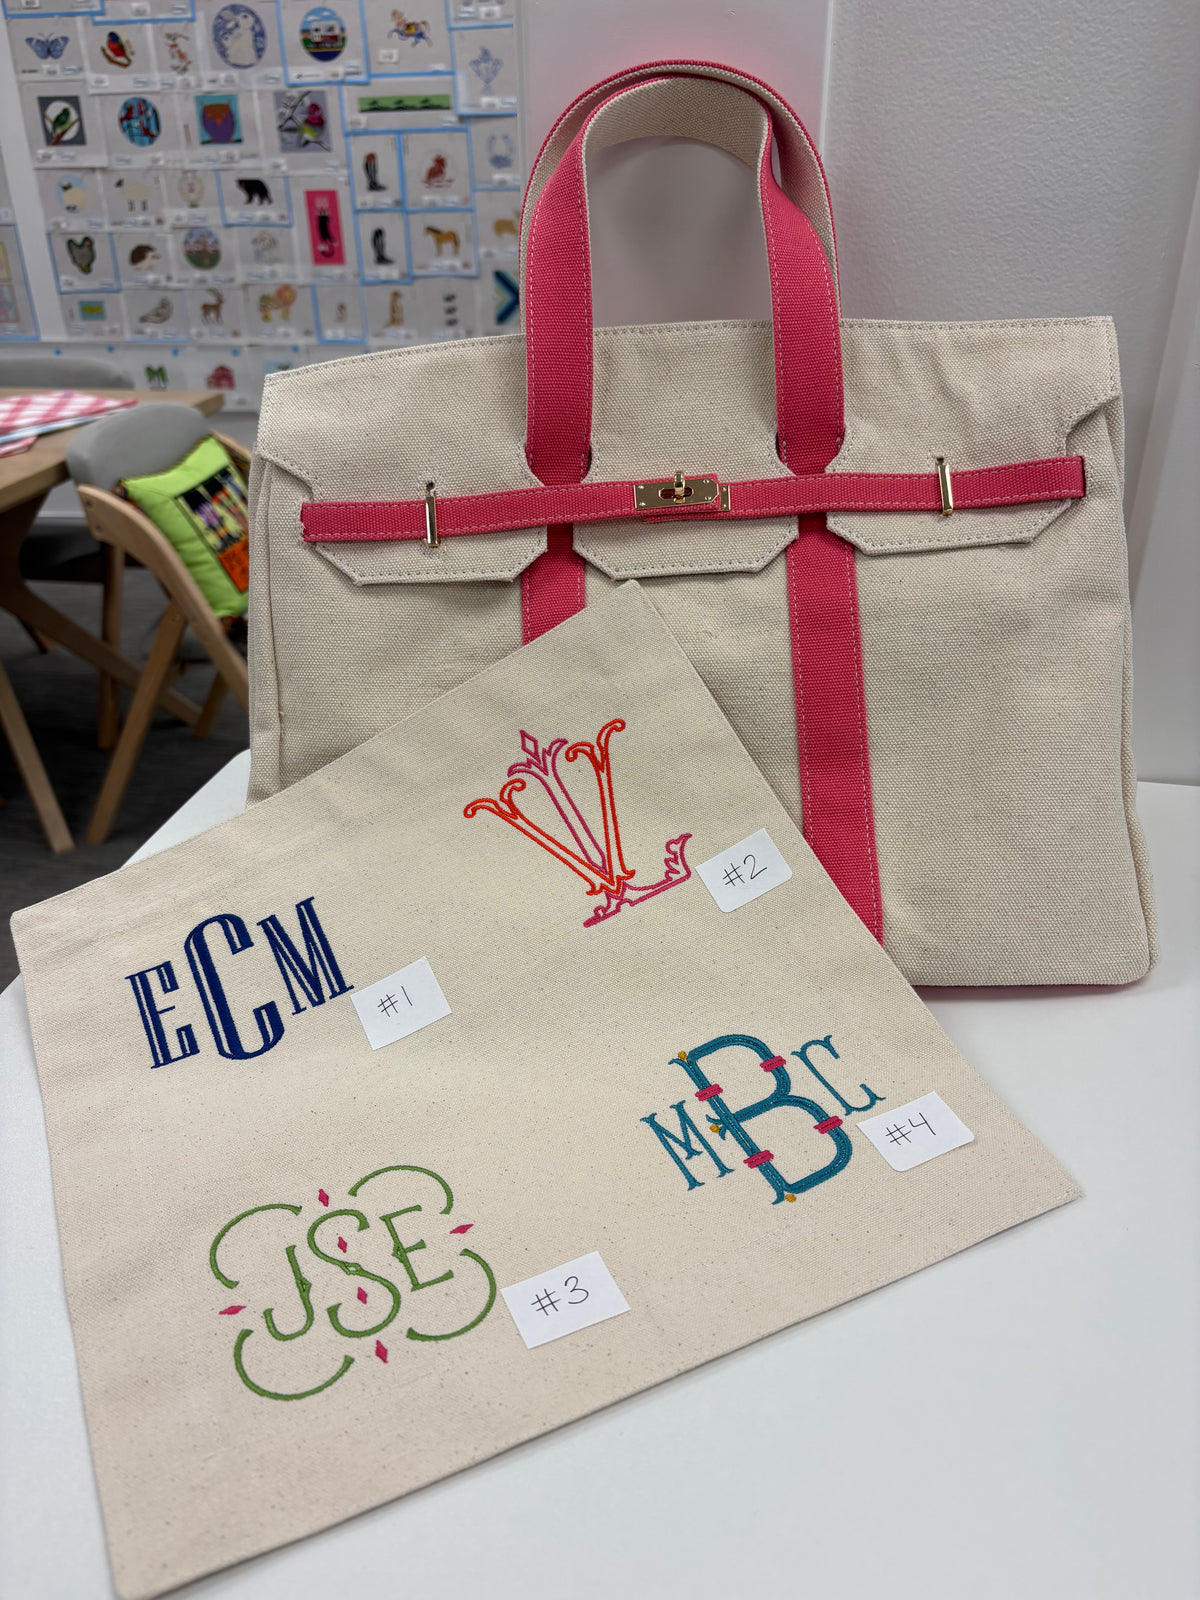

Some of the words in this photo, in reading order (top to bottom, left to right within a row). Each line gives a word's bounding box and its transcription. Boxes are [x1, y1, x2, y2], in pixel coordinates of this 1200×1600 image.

[722, 854, 768, 887] #2
[124, 896, 355, 1069] ECM
[377, 985, 413, 1018] #1
[885, 1112, 936, 1146] #4
[530, 1275, 590, 1317] #3
